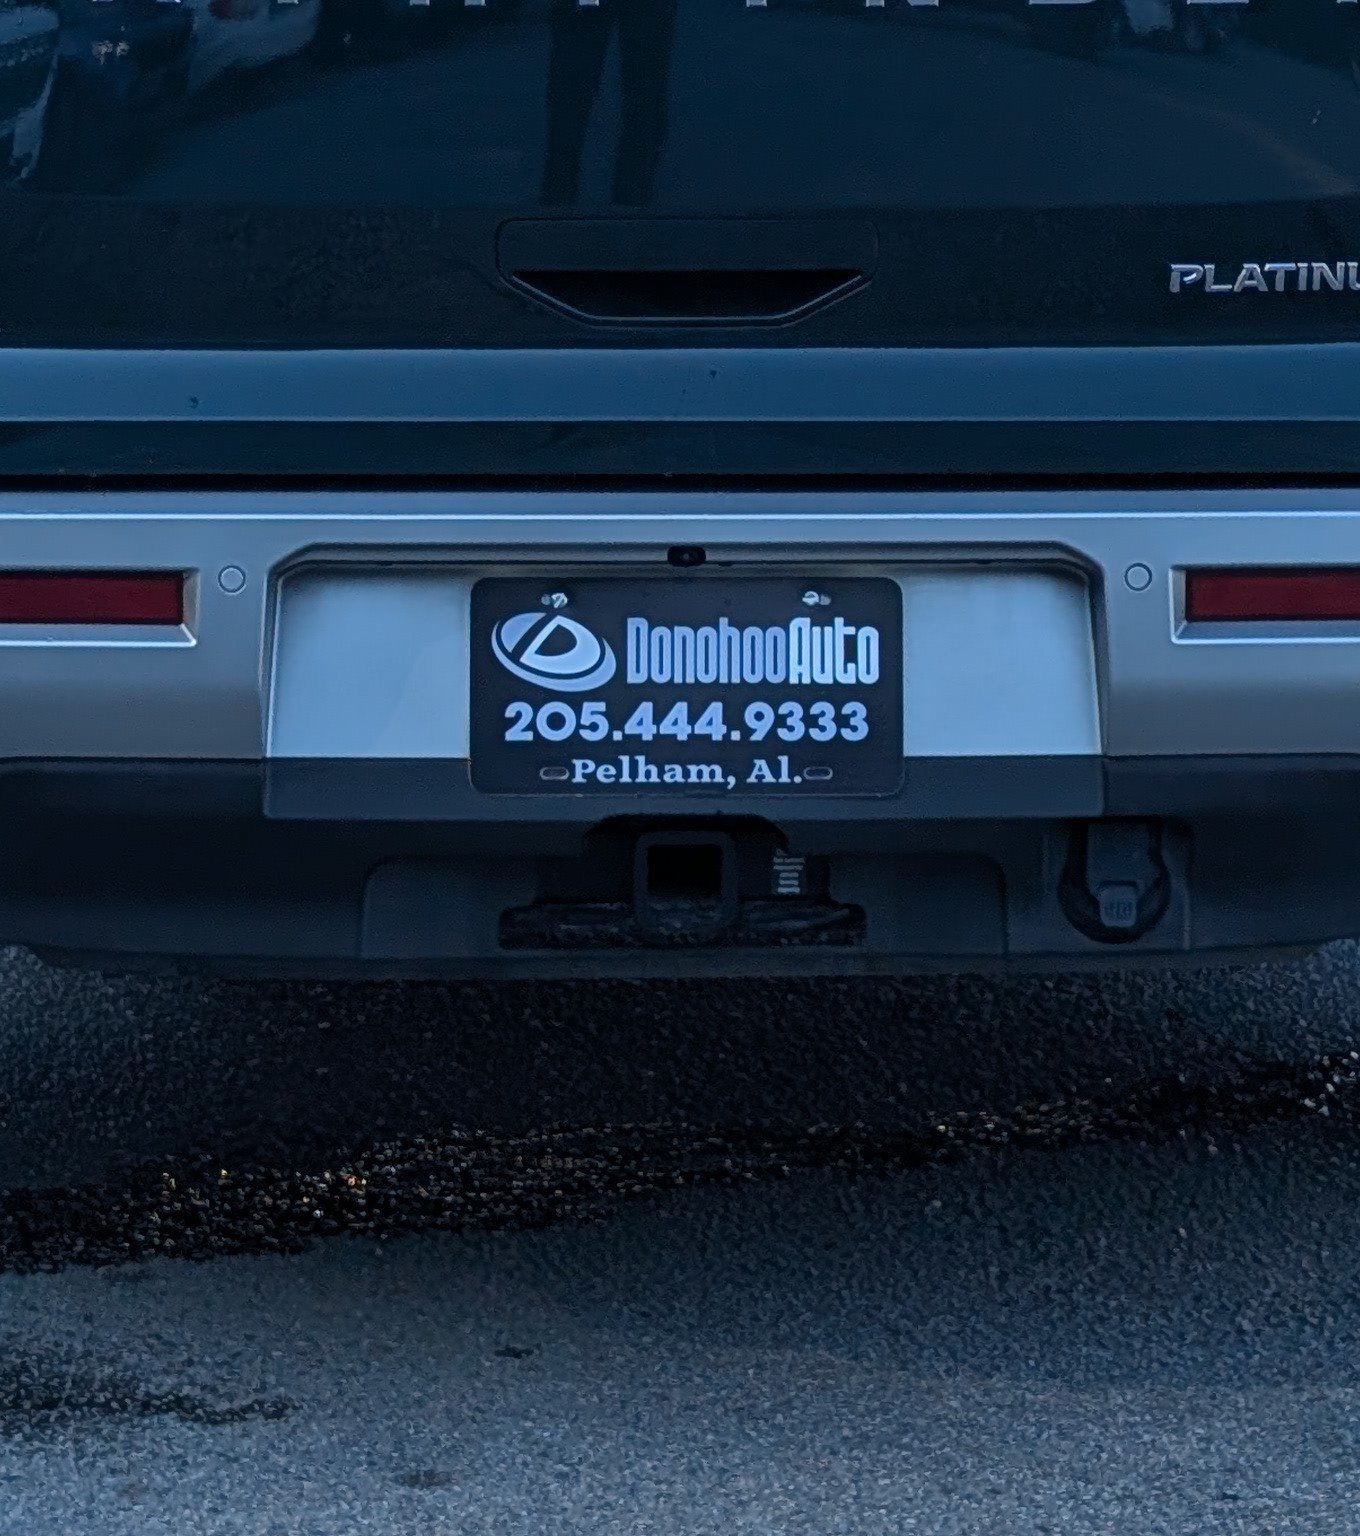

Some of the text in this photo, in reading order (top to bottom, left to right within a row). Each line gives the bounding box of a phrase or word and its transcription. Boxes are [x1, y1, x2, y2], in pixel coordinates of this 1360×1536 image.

[626, 616, 880, 685] DonohooAuto
[504, 700, 870, 742] 205.444.9333
[571, 755, 803, 790] Pelham, Al.
